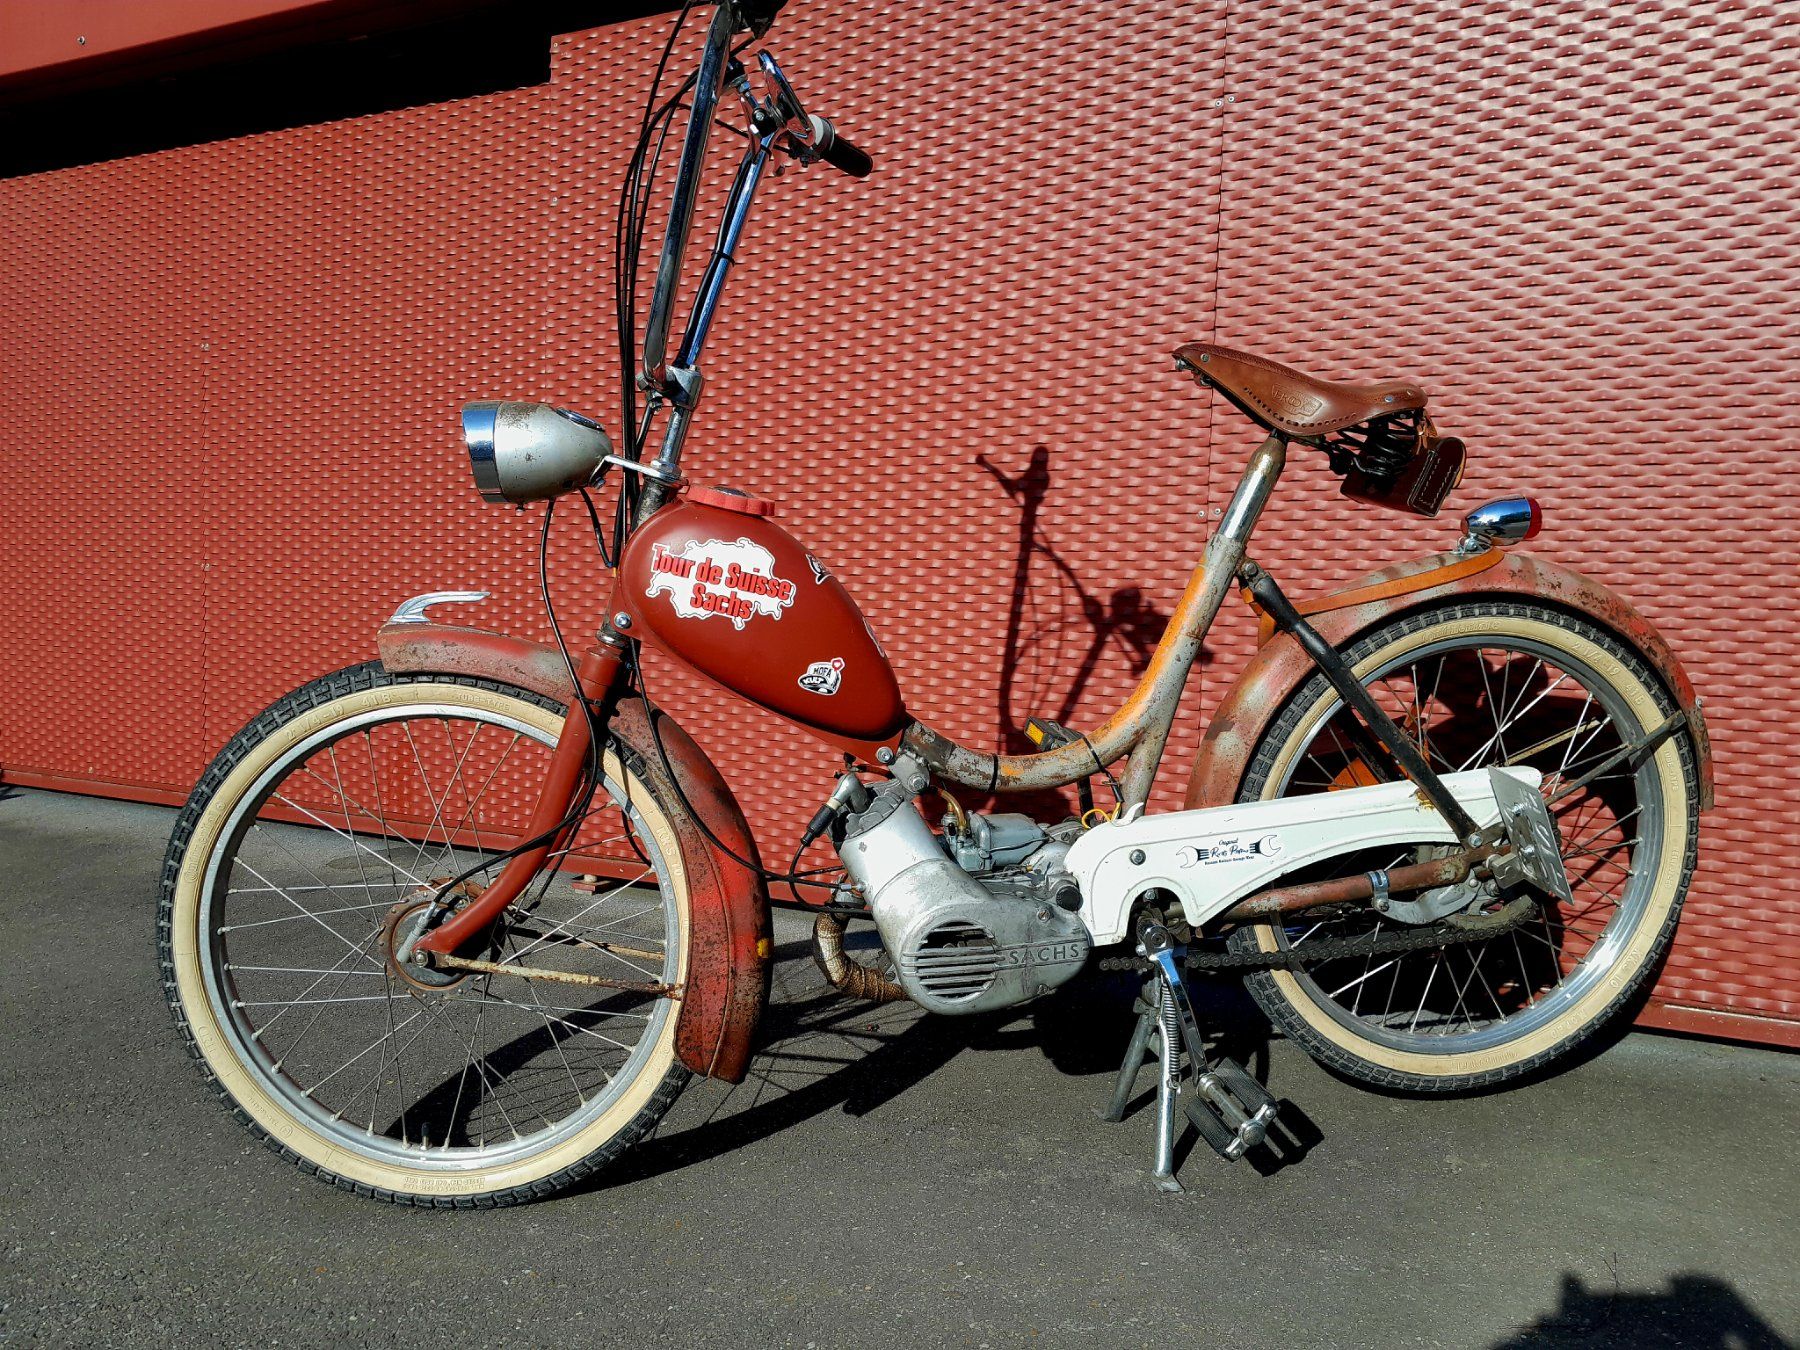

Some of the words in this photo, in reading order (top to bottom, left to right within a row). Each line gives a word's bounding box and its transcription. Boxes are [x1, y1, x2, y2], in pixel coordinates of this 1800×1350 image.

[653, 545, 696, 578] Tour
[695, 557, 723, 585] de
[725, 562, 792, 600] Suisse
[690, 583, 753, 619] Sachs
[801, 675, 824, 686] KULT
[813, 667, 832, 678] MOFA
[1009, 943, 1079, 964] SACHS
